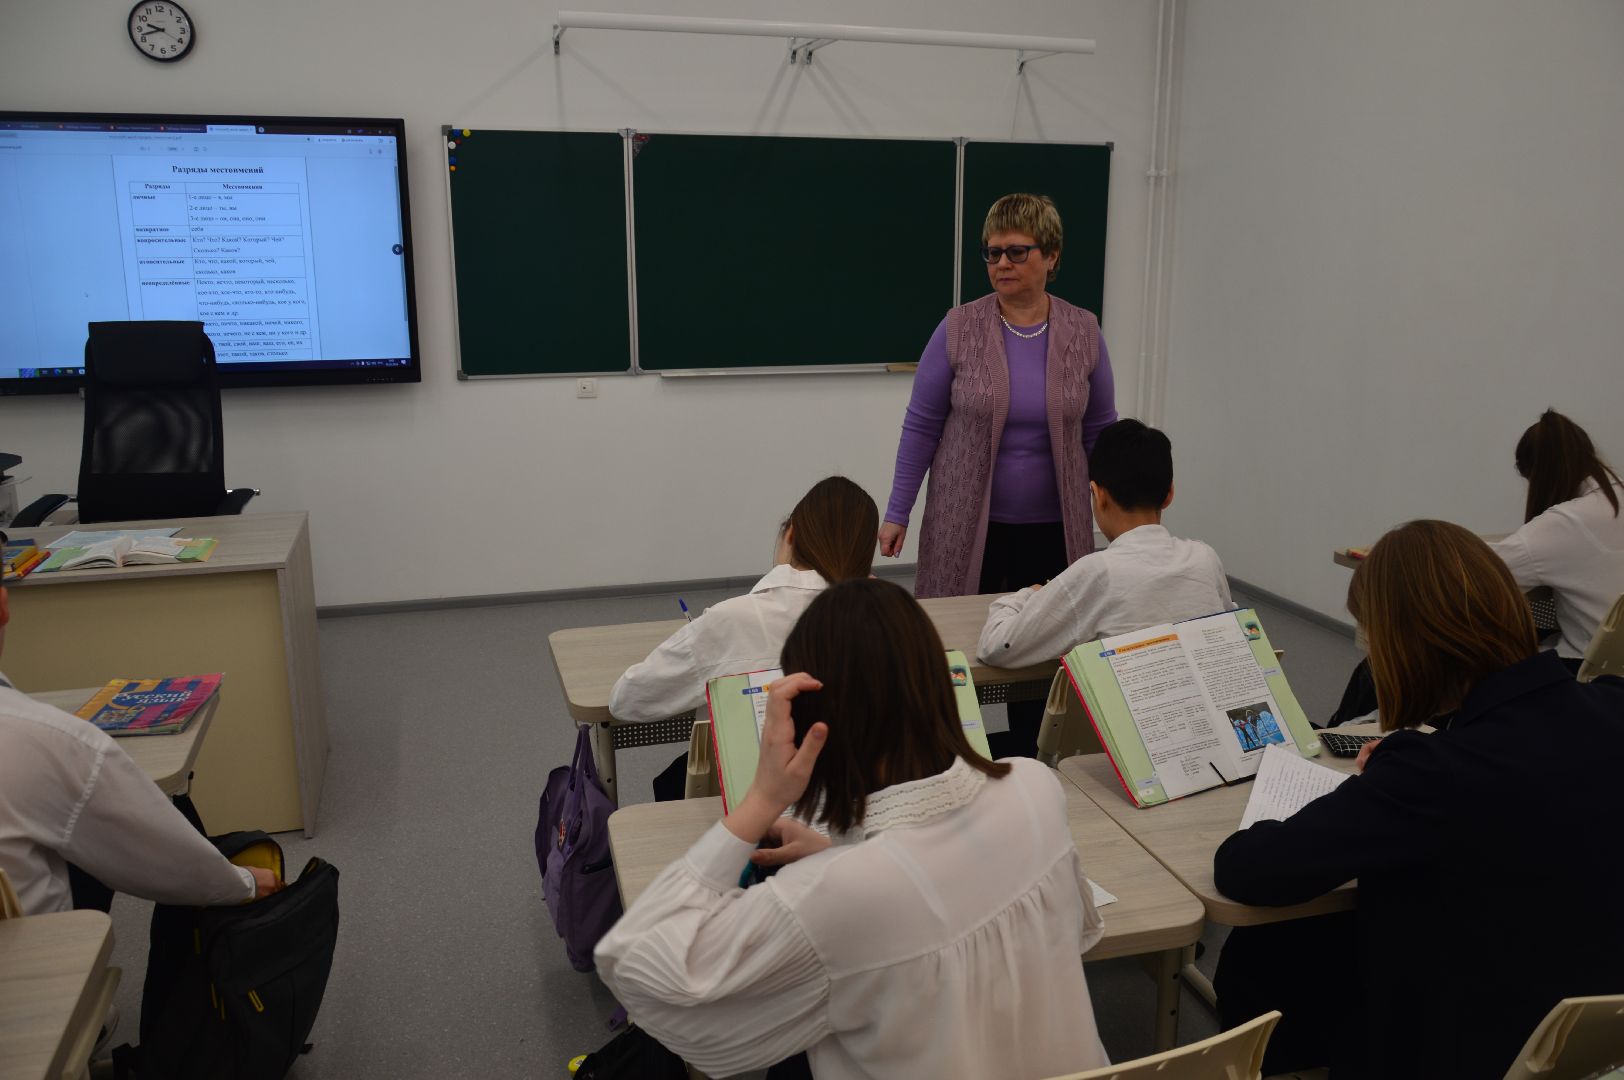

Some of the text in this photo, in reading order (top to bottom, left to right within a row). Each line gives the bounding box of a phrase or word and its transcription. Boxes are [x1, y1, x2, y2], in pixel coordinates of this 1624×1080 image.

[172, 165, 264, 174] Разряды местоимений
[112, 690, 192, 702] Русский
